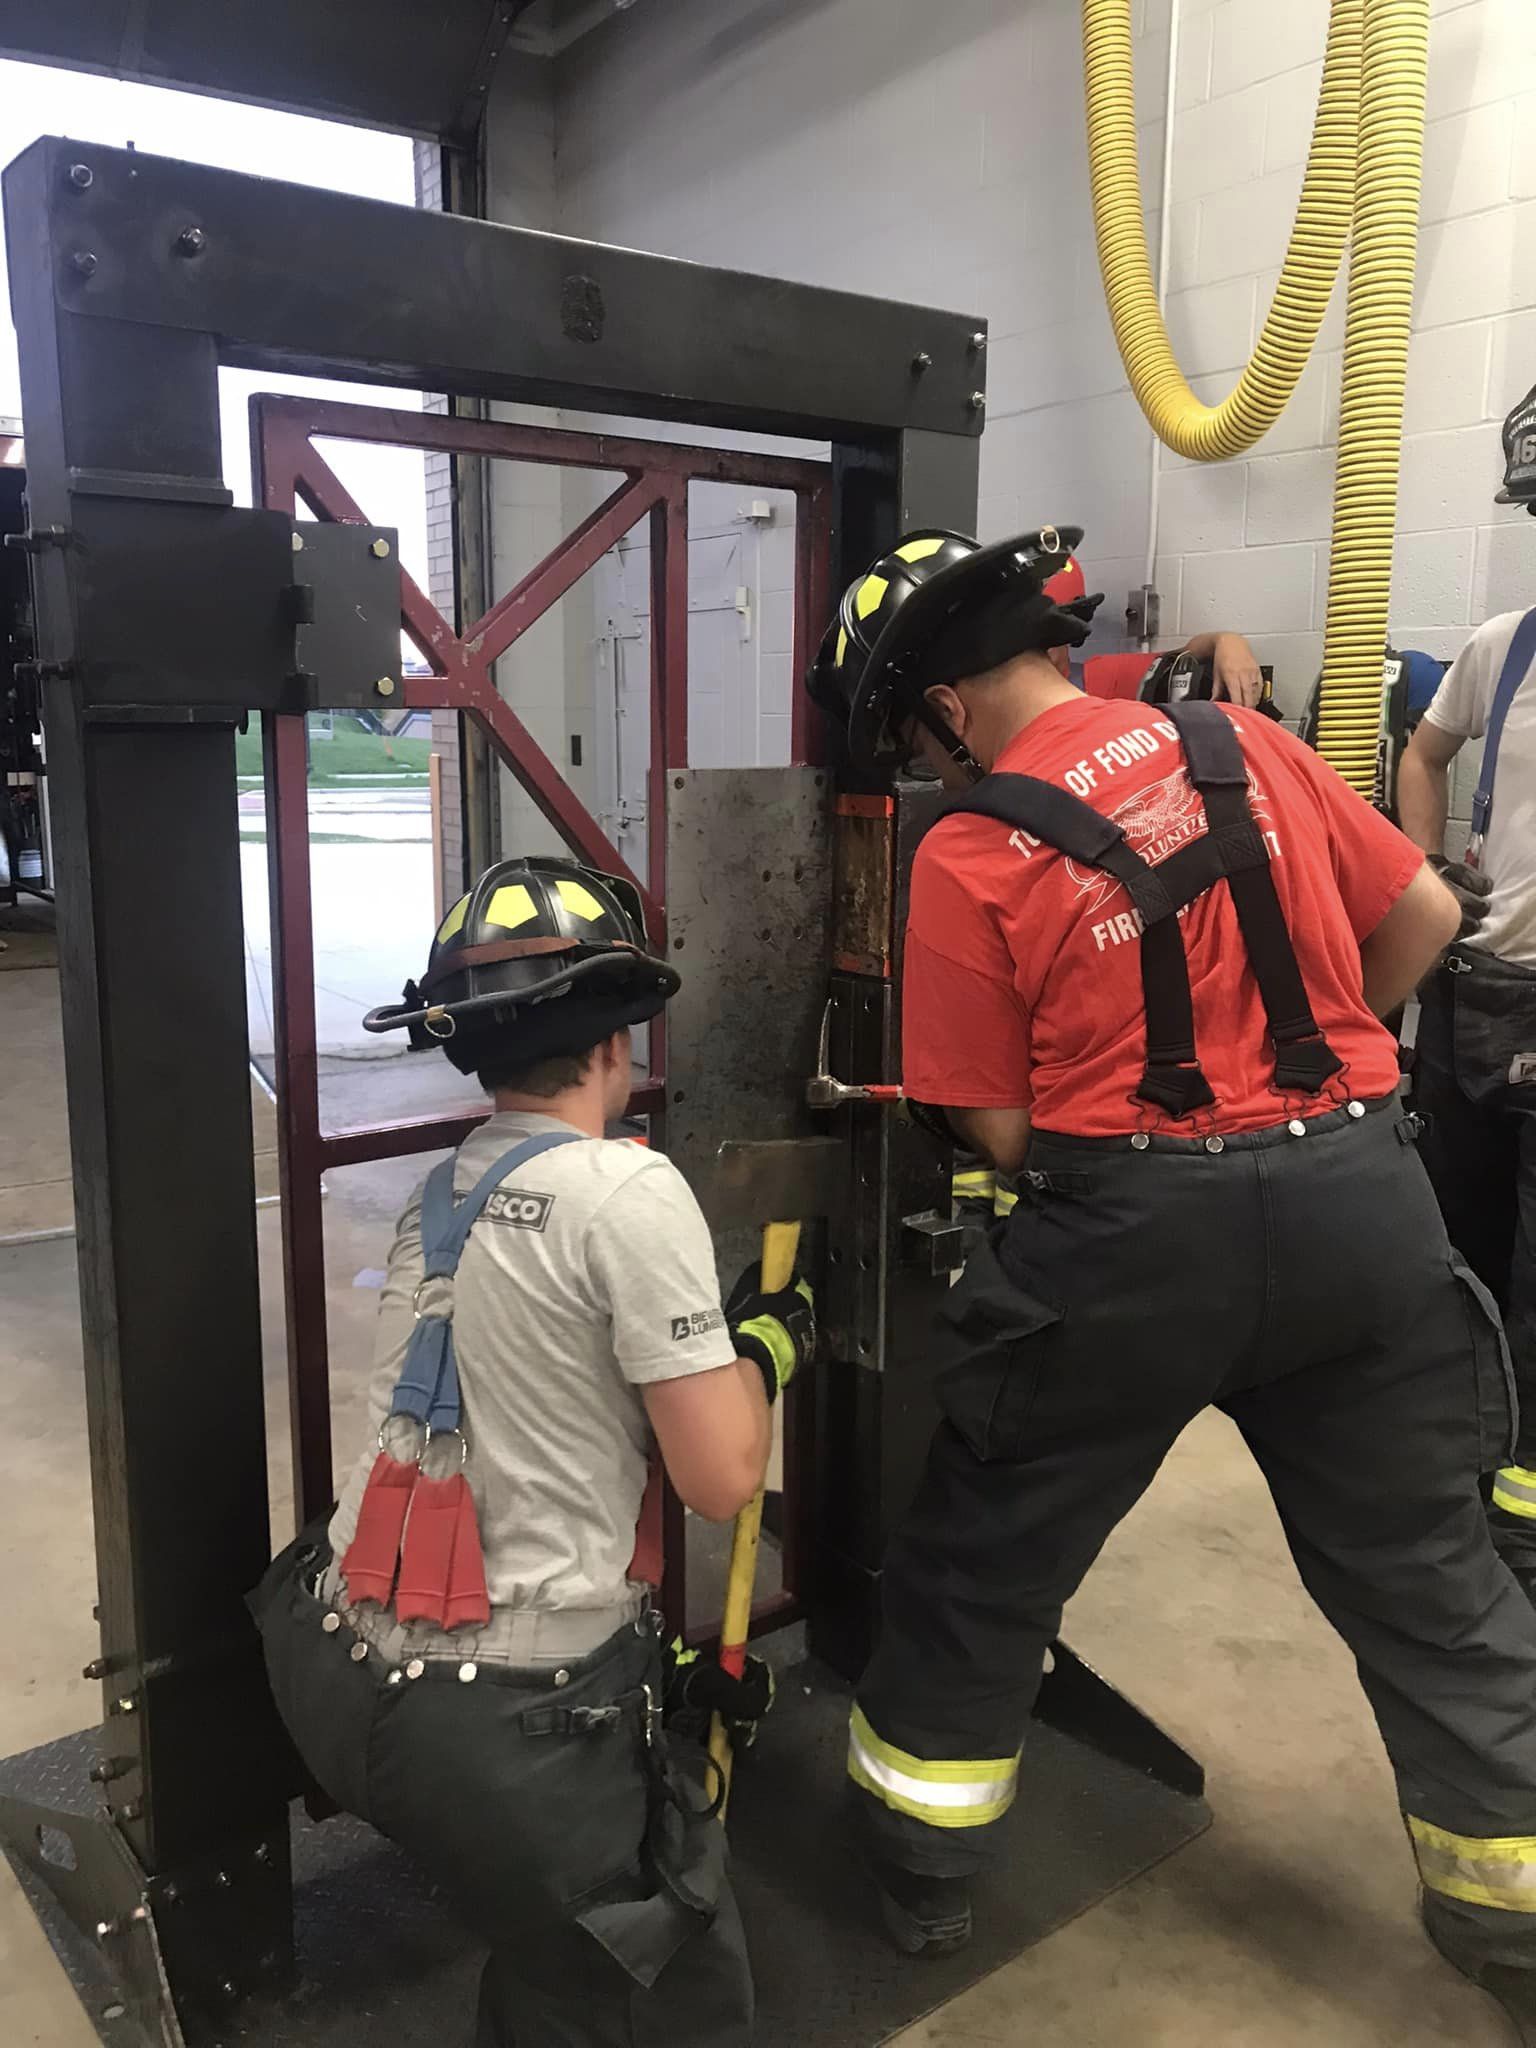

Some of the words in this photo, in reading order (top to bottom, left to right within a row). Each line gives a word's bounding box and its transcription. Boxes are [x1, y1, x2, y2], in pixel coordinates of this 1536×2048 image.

[1064, 760, 1098, 798] OF
[1093, 728, 1160, 776] FOND
[1152, 719, 1180, 742] D
[484, 1192, 542, 1222] SCO
